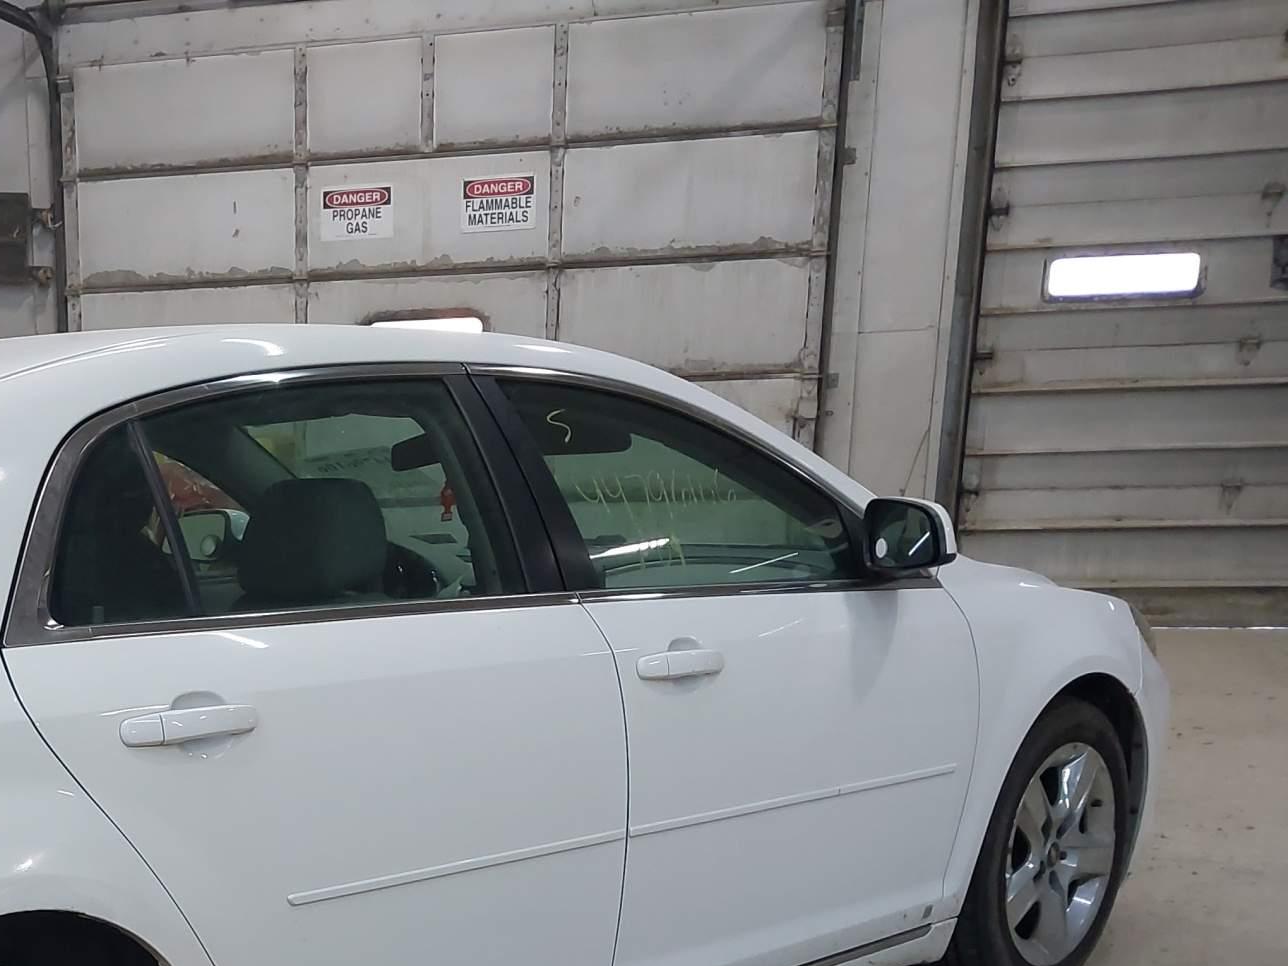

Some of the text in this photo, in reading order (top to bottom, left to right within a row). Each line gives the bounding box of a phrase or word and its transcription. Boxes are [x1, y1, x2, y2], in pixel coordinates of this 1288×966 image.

[473, 181, 523, 194] DANGER
[333, 192, 381, 204] DANGER
[465, 196, 532, 213] FLAMMABLE
[332, 207, 382, 221] PROPANE
[468, 210, 529, 226] MATERIALS
[346, 221, 368, 234] GAS
